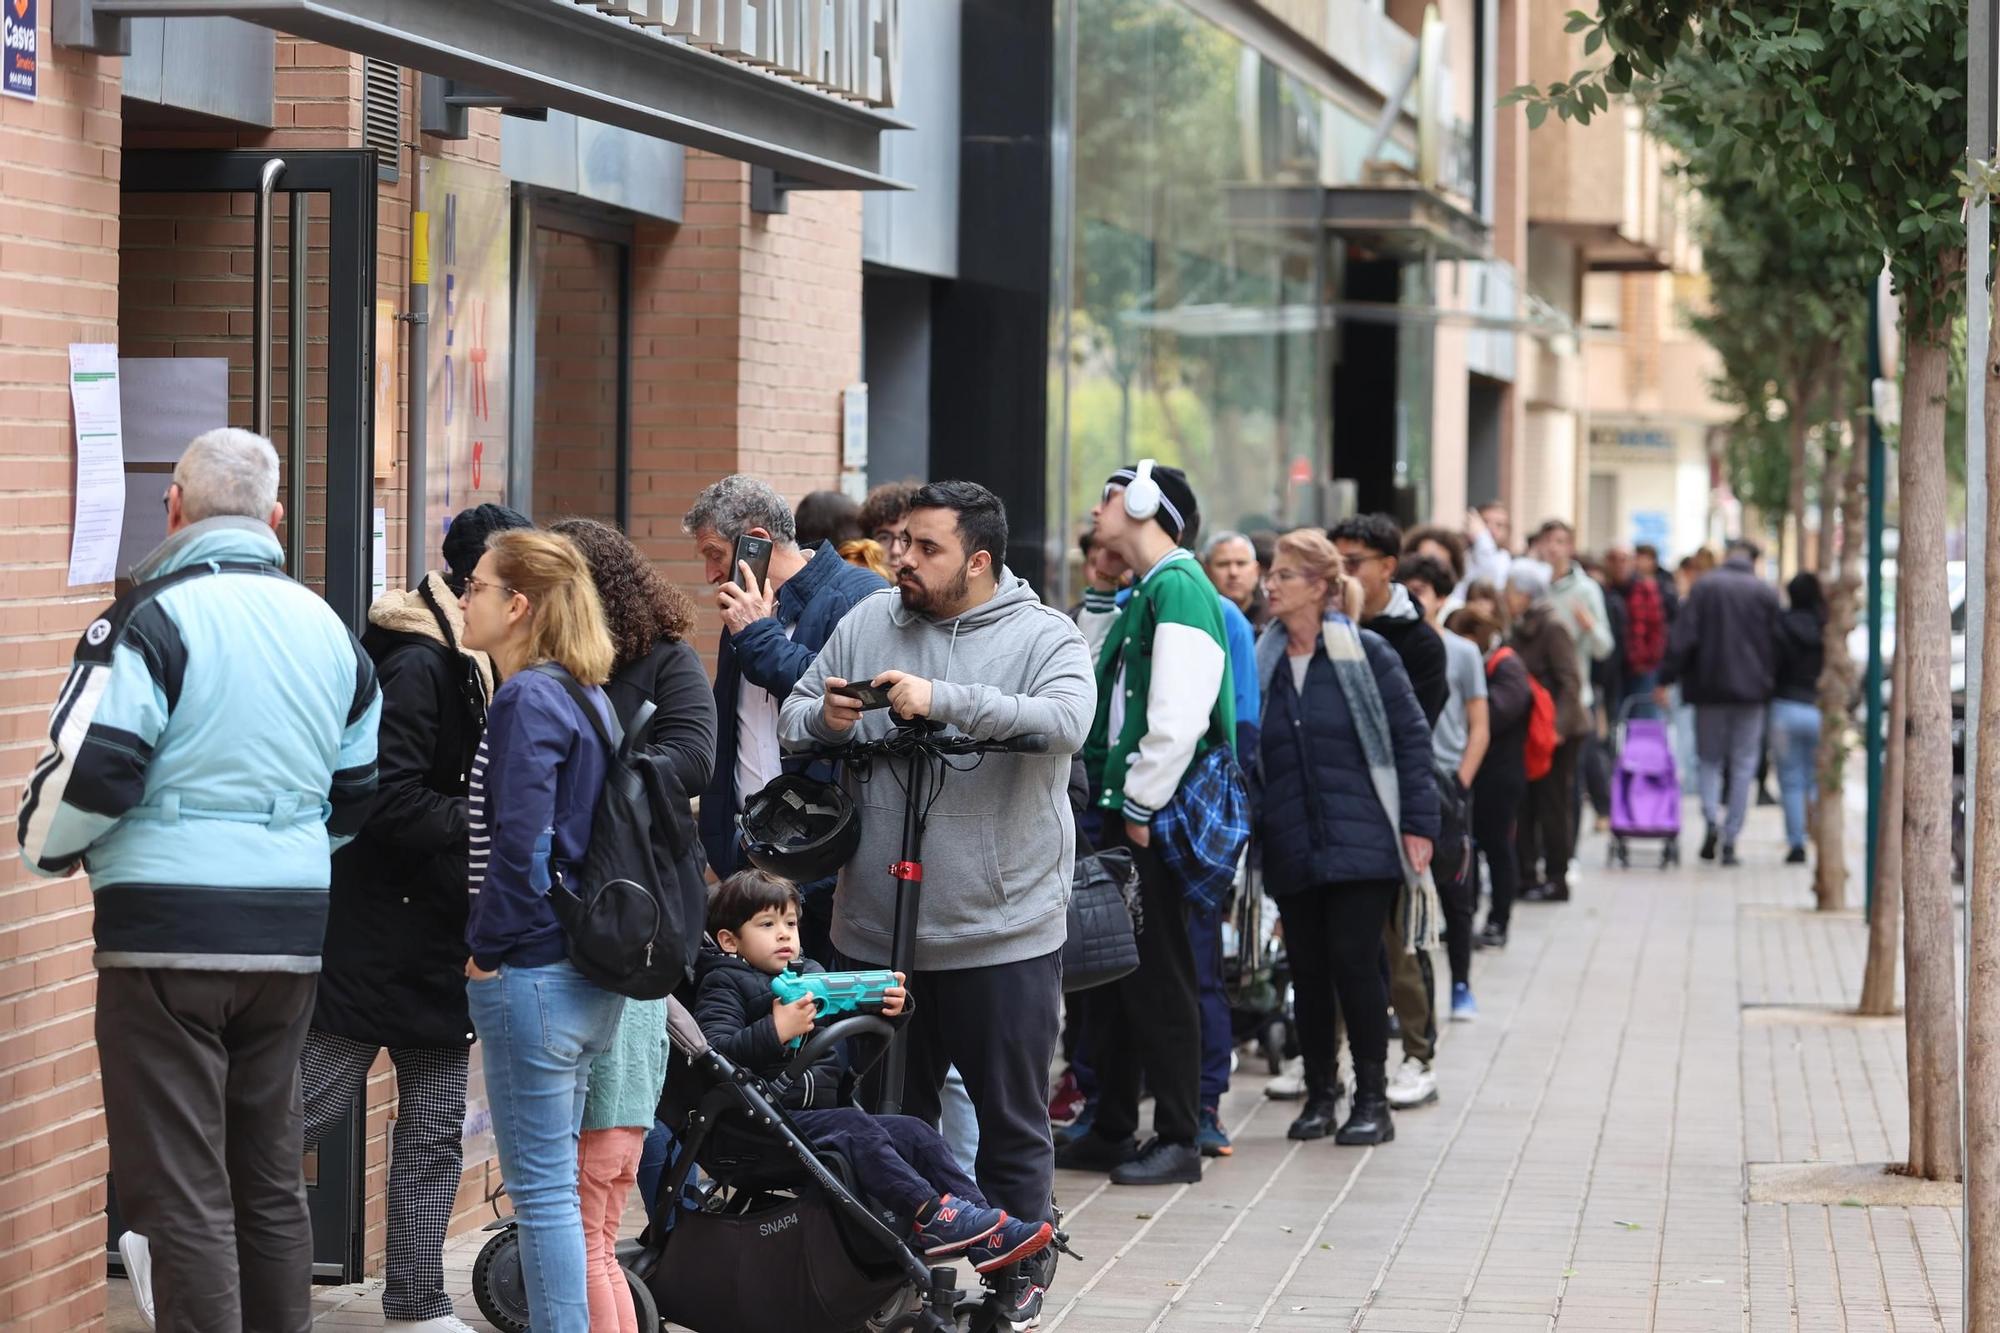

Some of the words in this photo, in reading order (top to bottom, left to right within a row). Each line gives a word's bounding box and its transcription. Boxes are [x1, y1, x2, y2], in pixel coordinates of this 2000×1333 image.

[4, 16, 35, 52] Casva
[759, 1212, 799, 1237] SNAP4
[937, 1207, 959, 1222] N
[987, 1233, 1004, 1249] N
